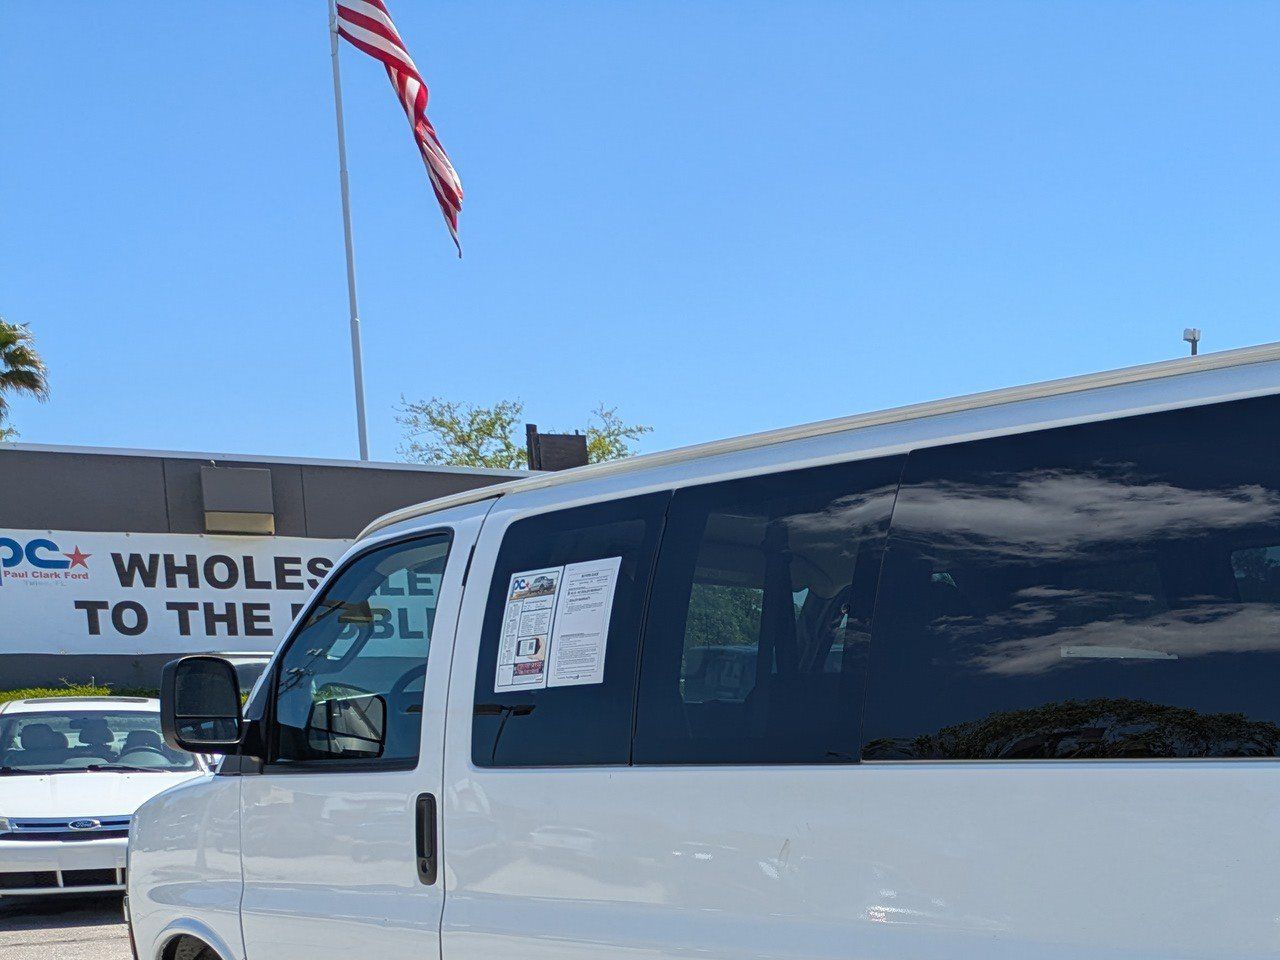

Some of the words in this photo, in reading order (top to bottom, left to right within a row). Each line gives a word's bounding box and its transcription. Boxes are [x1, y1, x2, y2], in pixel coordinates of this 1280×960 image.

[3, 570, 28, 578] Paul
[32, 571, 61, 579] Clark
[64, 571, 89, 580] Ford
[75, 600, 148, 636] TO
[166, 601, 273, 636] THE
